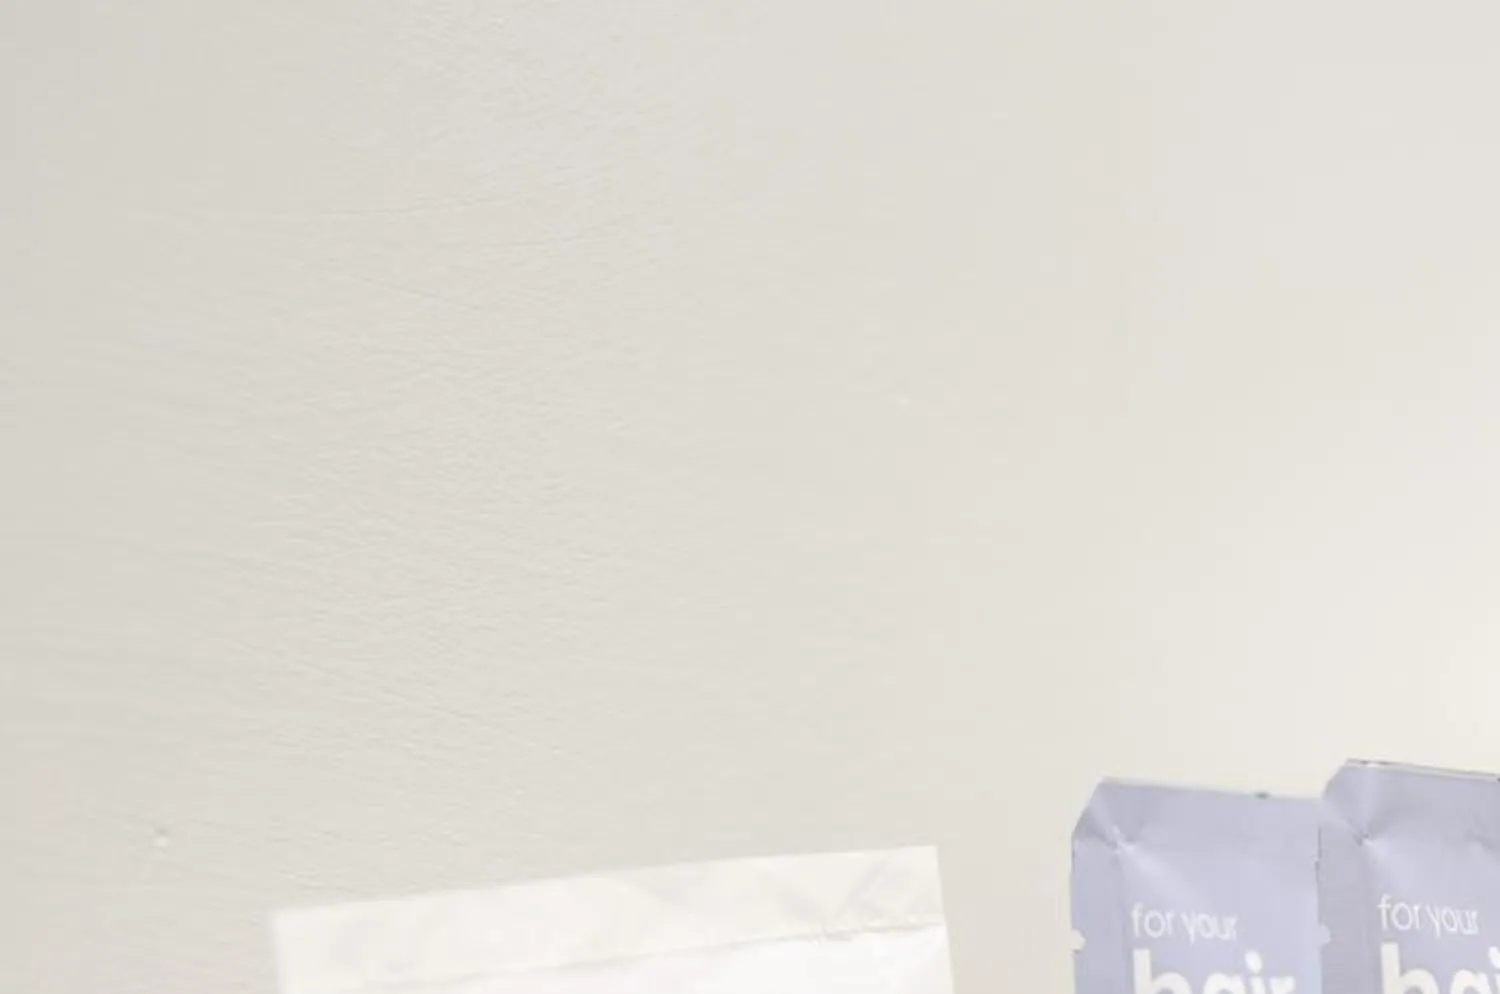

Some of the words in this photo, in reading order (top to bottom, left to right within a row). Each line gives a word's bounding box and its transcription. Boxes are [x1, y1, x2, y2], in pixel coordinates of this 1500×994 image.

[1131, 902, 1174, 938] for
[1181, 911, 1238, 944] your
[1378, 895, 1421, 932] for
[1424, 909, 1479, 938] your
